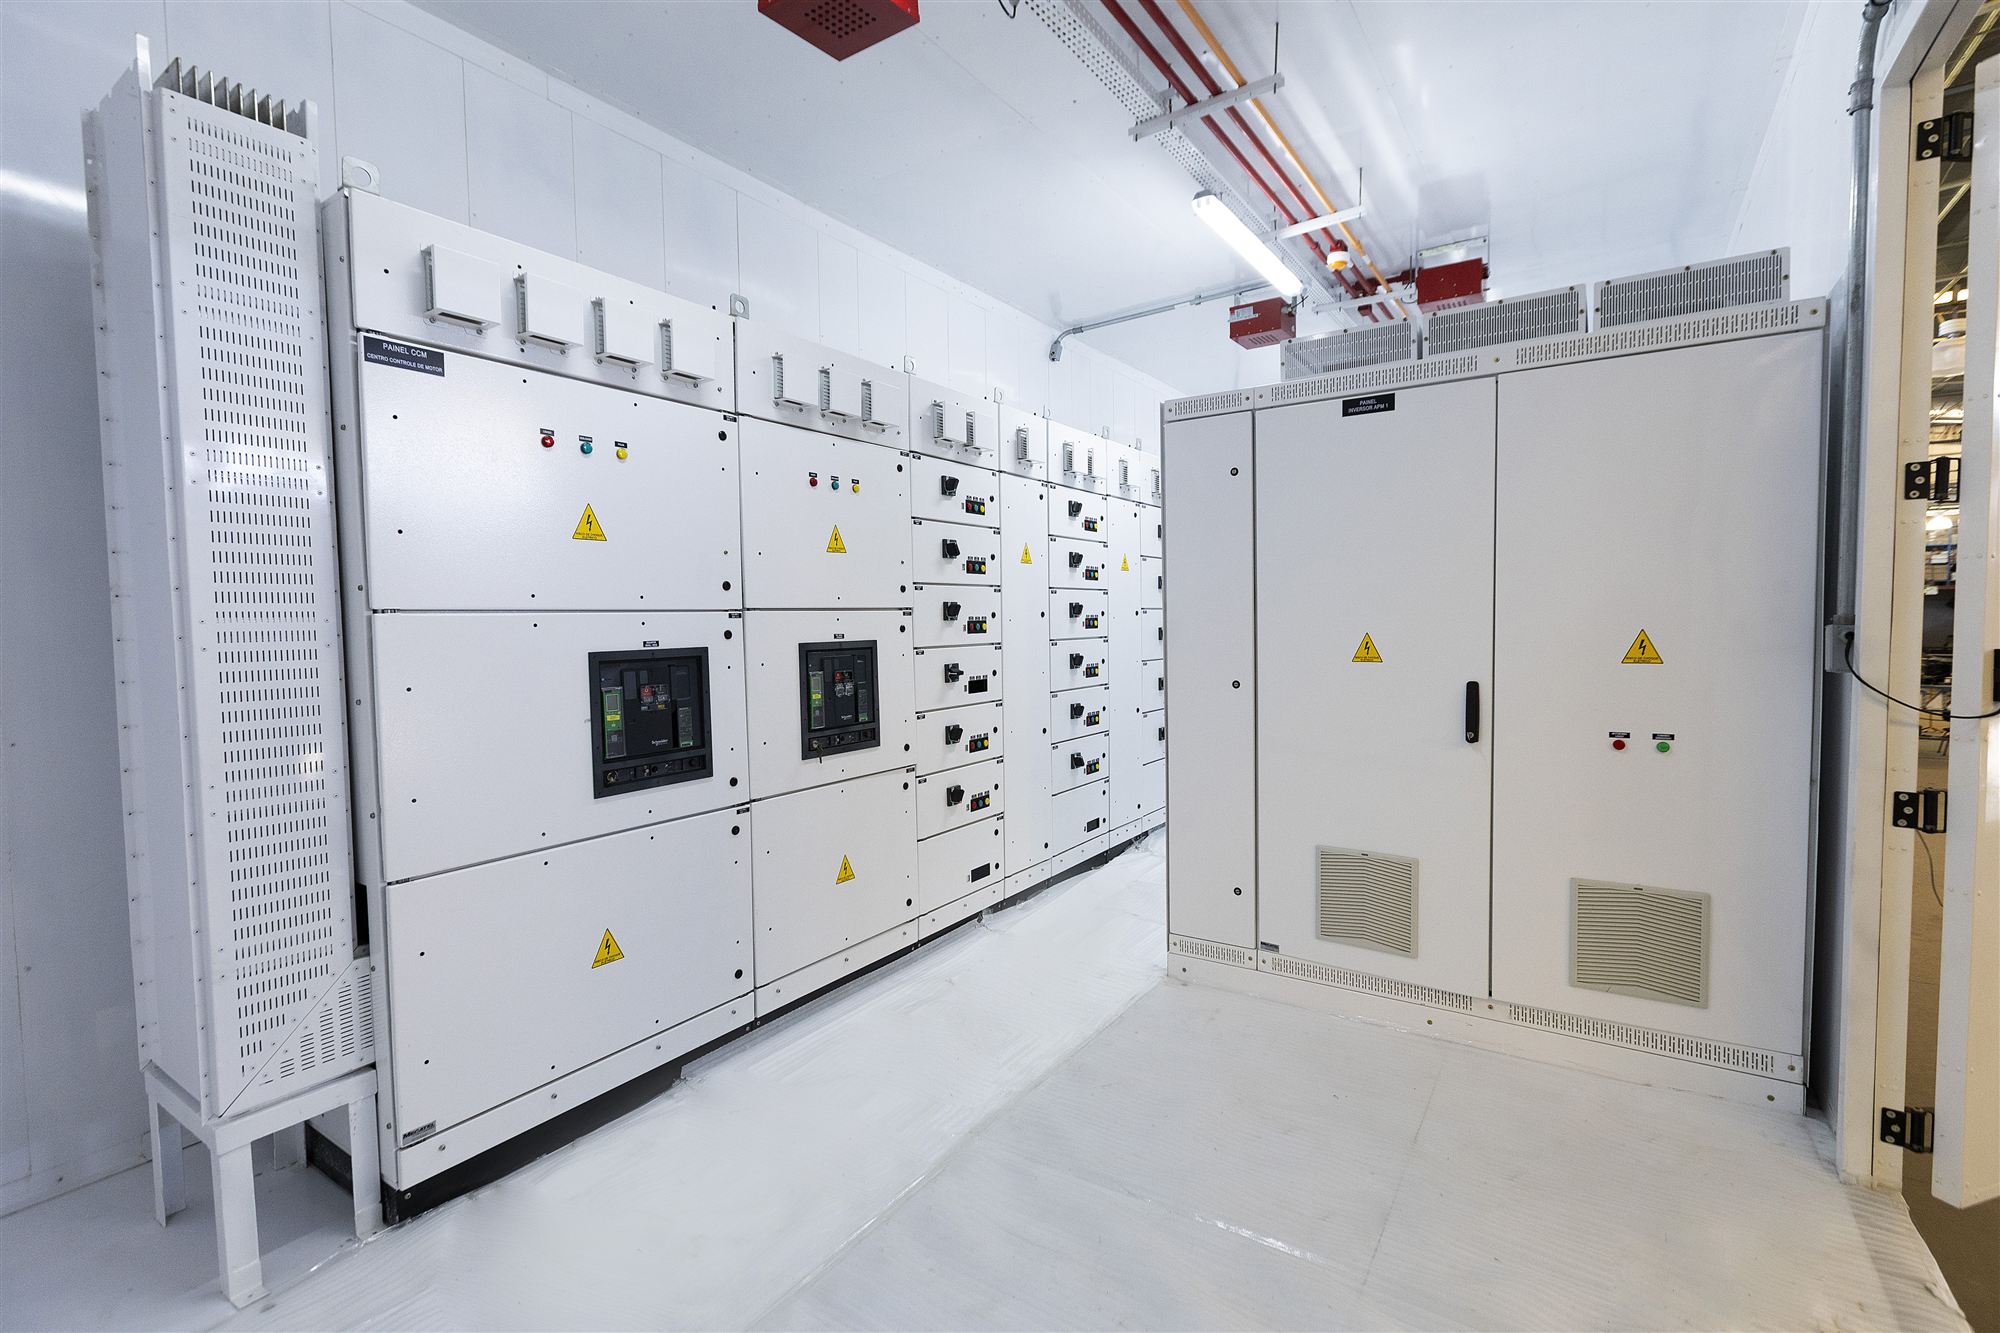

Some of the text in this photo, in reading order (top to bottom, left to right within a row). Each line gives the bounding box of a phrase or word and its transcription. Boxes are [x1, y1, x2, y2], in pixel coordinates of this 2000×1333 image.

[382, 342, 428, 359] PAINEL CCM
[366, 352, 389, 362] CENTRO
[389, 357, 416, 368] CONTROLE
[424, 364, 443, 373] MOTOR
[1359, 398, 1377, 406] PAINEL
